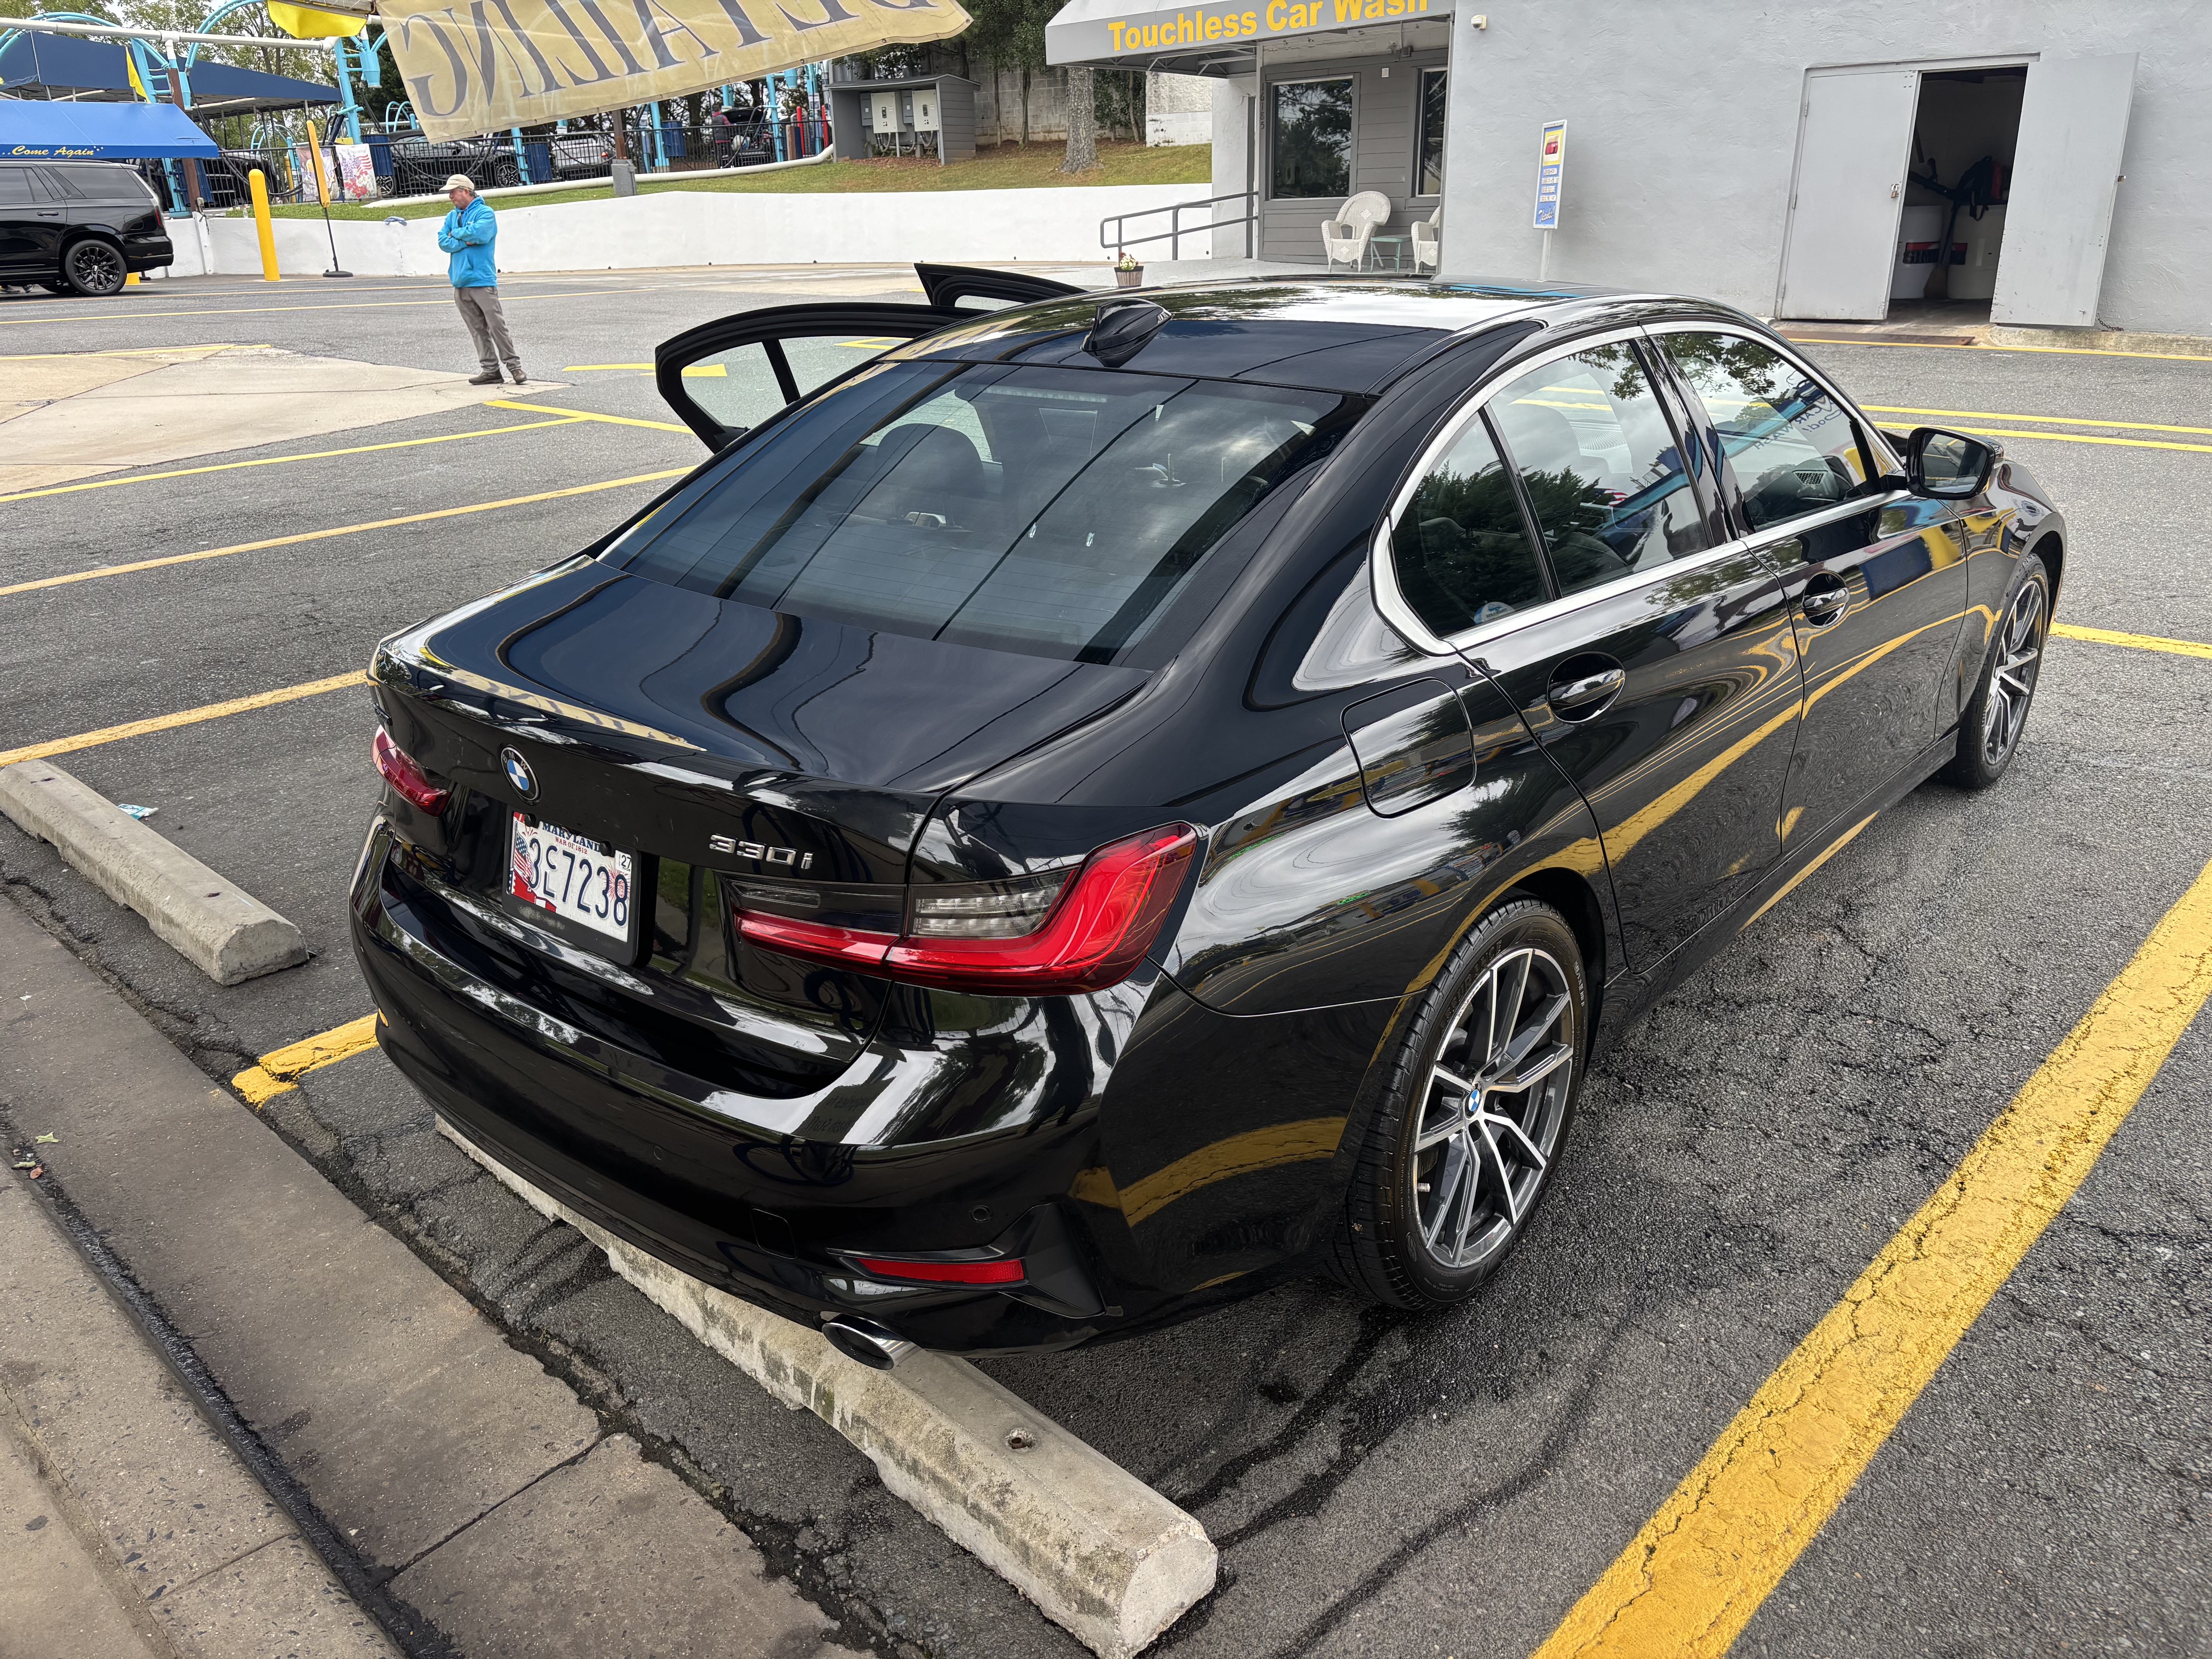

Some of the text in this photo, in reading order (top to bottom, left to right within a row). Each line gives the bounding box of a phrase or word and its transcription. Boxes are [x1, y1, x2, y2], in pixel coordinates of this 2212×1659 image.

[1108, 0, 1427, 51] Touchless Car Wash
[53, 146, 94, 158] Again
[502, 750, 528, 771] BMW
[555, 836, 567, 845] WAR
[575, 844, 588, 854] 1812
